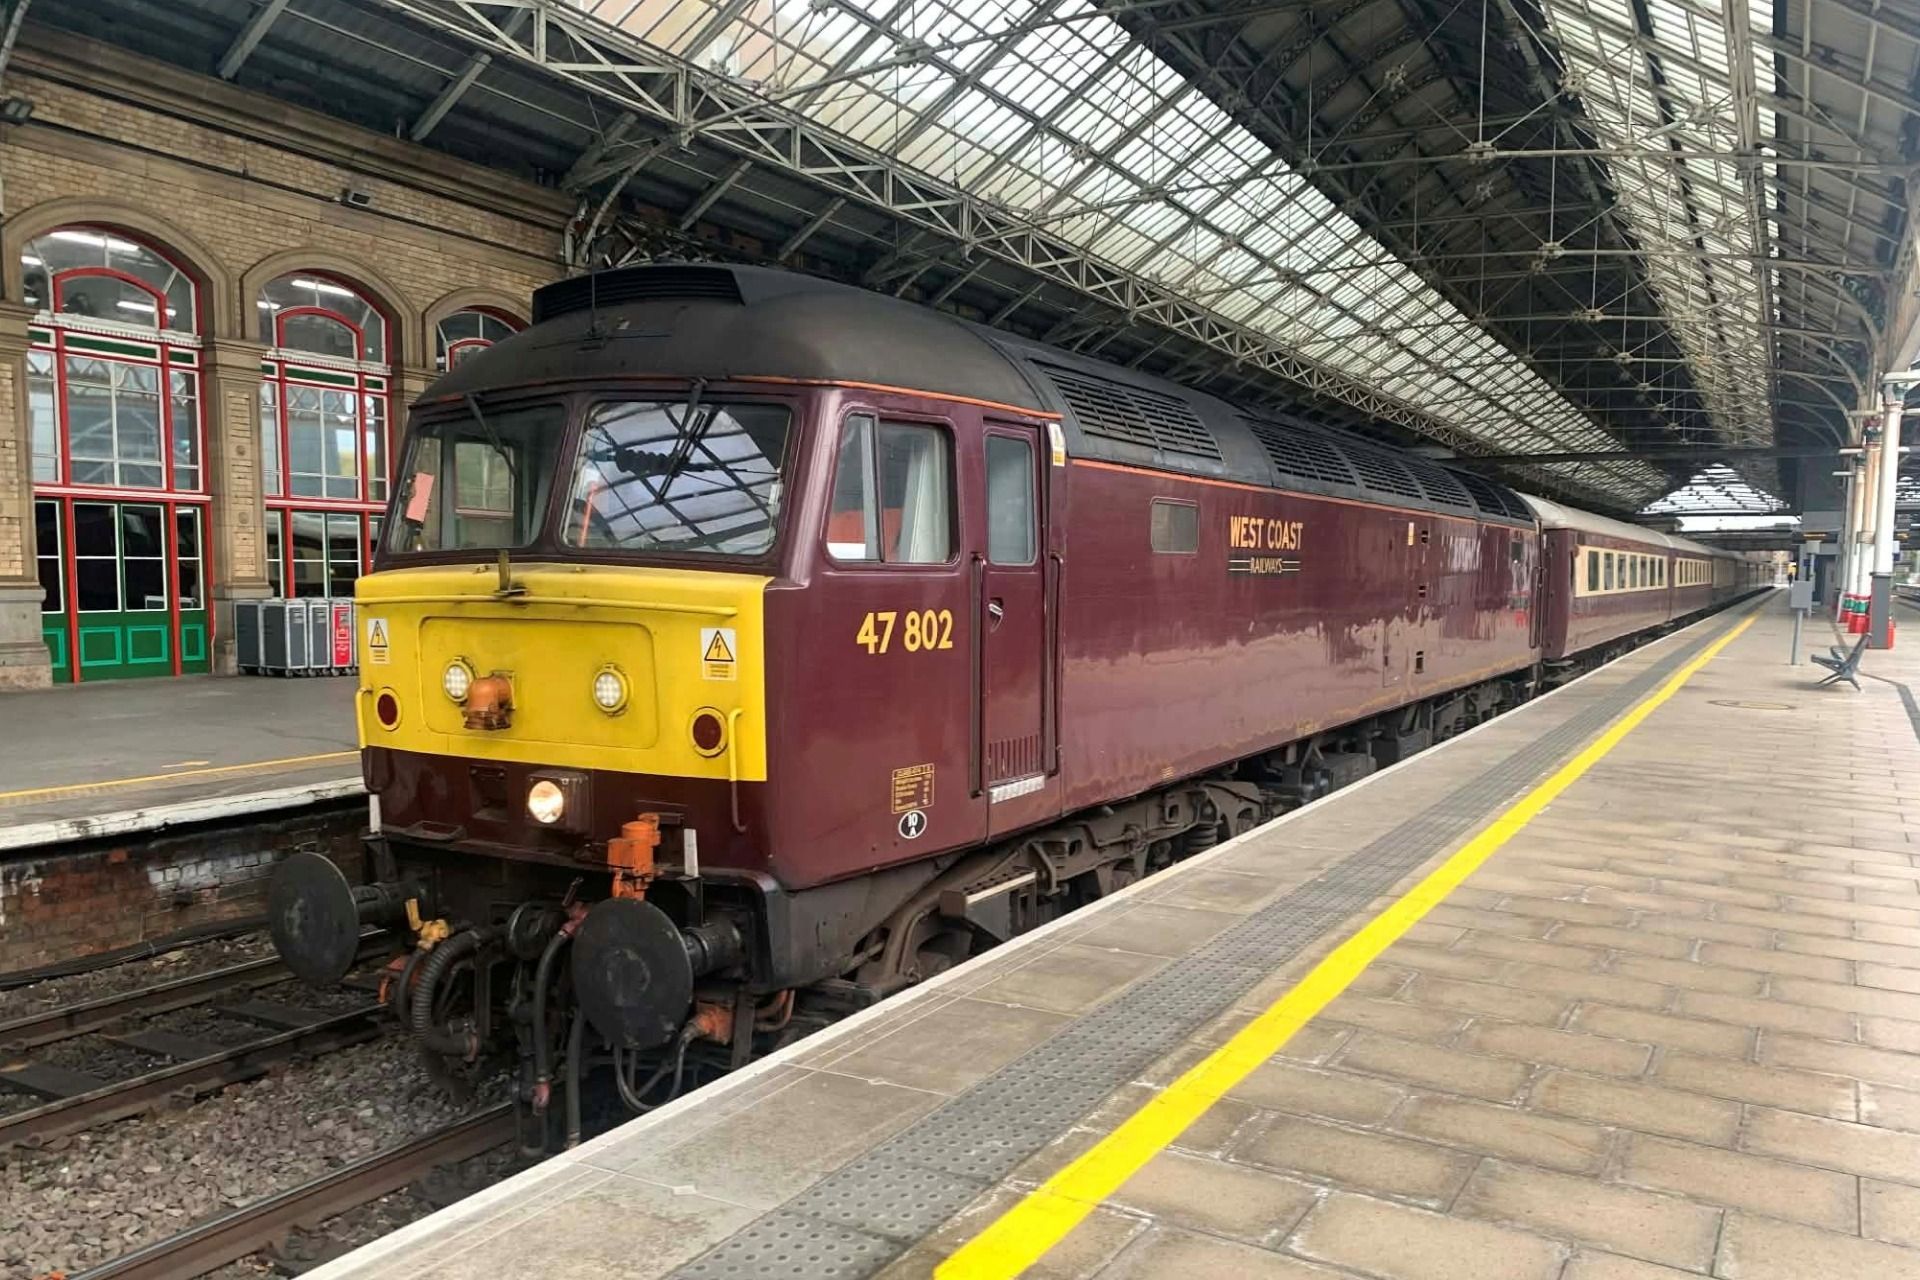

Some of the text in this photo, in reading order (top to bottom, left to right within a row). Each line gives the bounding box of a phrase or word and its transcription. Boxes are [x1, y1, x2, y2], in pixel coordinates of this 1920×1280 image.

[1230, 516, 1303, 550] WEST COAST
[1250, 557, 1282, 574] RAILWAYS
[856, 609, 953, 655] 47 802
[907, 813, 918, 827] 10
[909, 826, 917, 837] A
